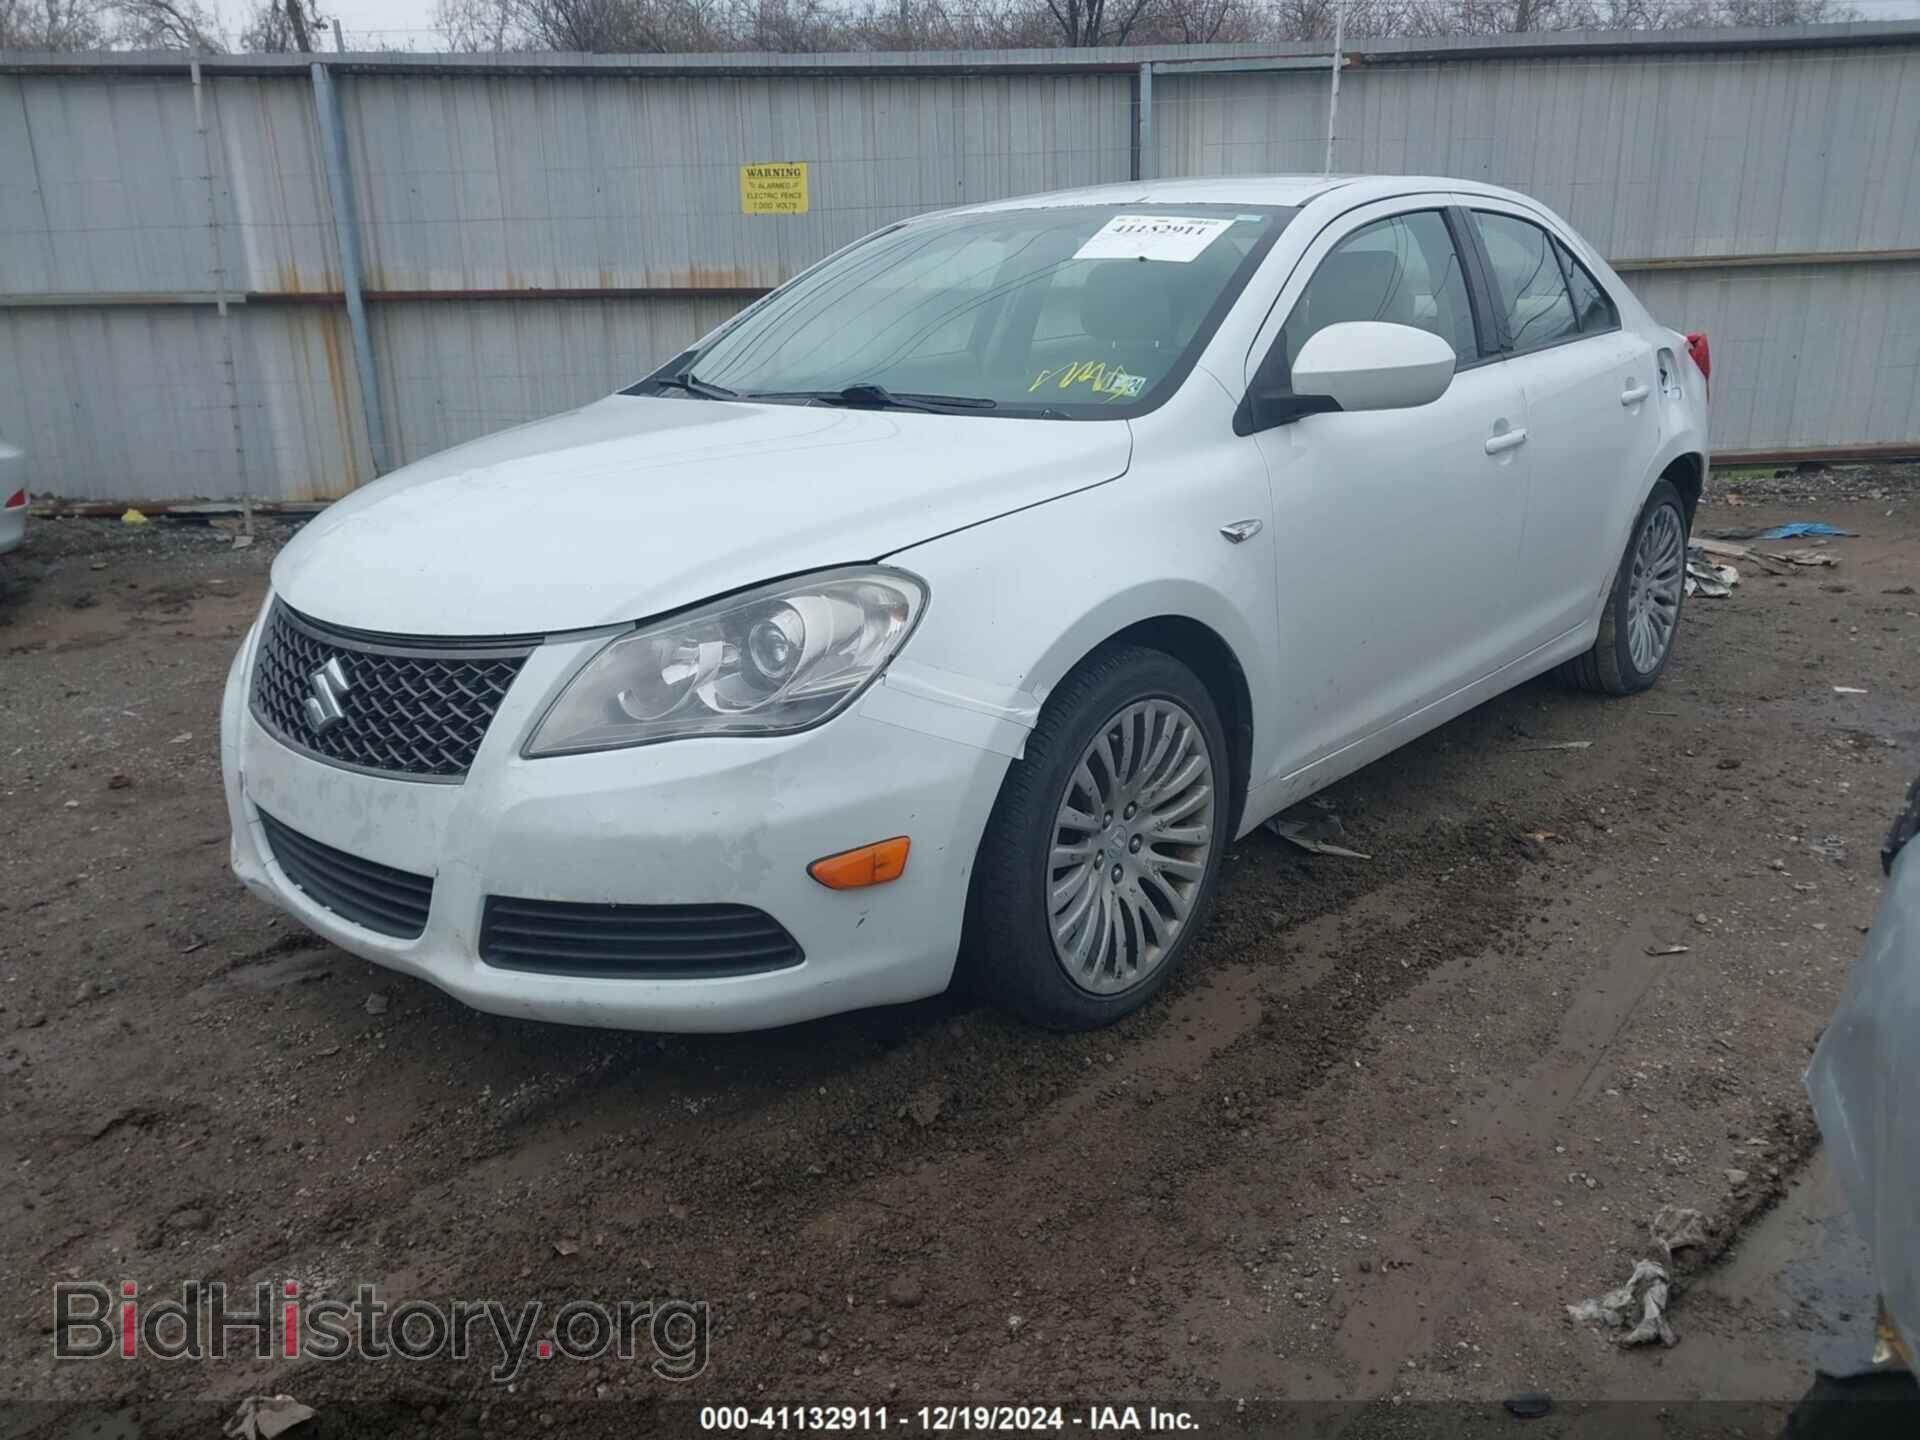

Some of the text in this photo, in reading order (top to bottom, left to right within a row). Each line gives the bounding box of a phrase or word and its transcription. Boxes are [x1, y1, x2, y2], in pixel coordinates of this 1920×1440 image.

[746, 167, 801, 177] WARNING
[746, 191, 802, 200] ELECTRIC FENCE
